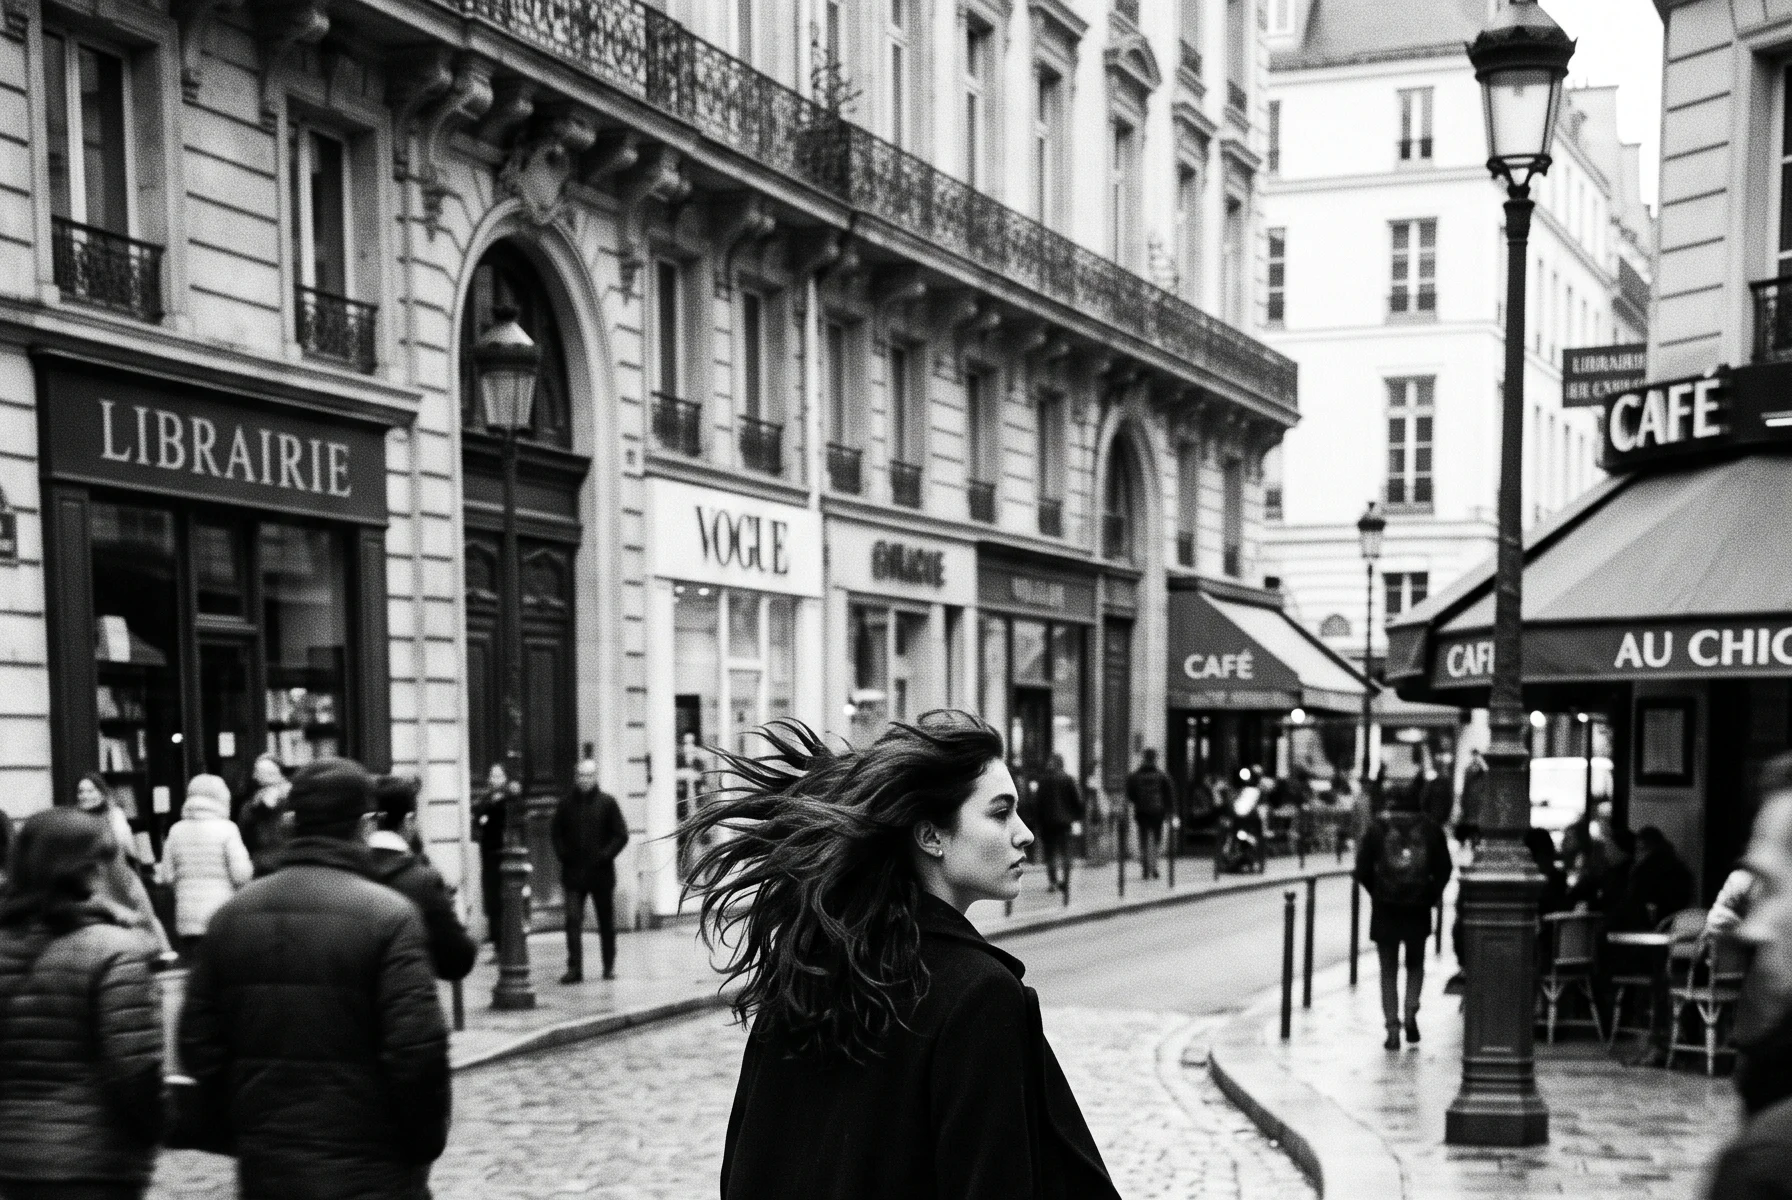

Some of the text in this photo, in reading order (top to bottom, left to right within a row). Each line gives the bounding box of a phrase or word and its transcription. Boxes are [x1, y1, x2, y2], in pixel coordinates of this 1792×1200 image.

[101, 400, 351, 498] LIBRAIRIE
[695, 505, 789, 575] VOGUE
[1183, 648, 1254, 680] CAFÉ
[1613, 631, 1674, 669] AU
